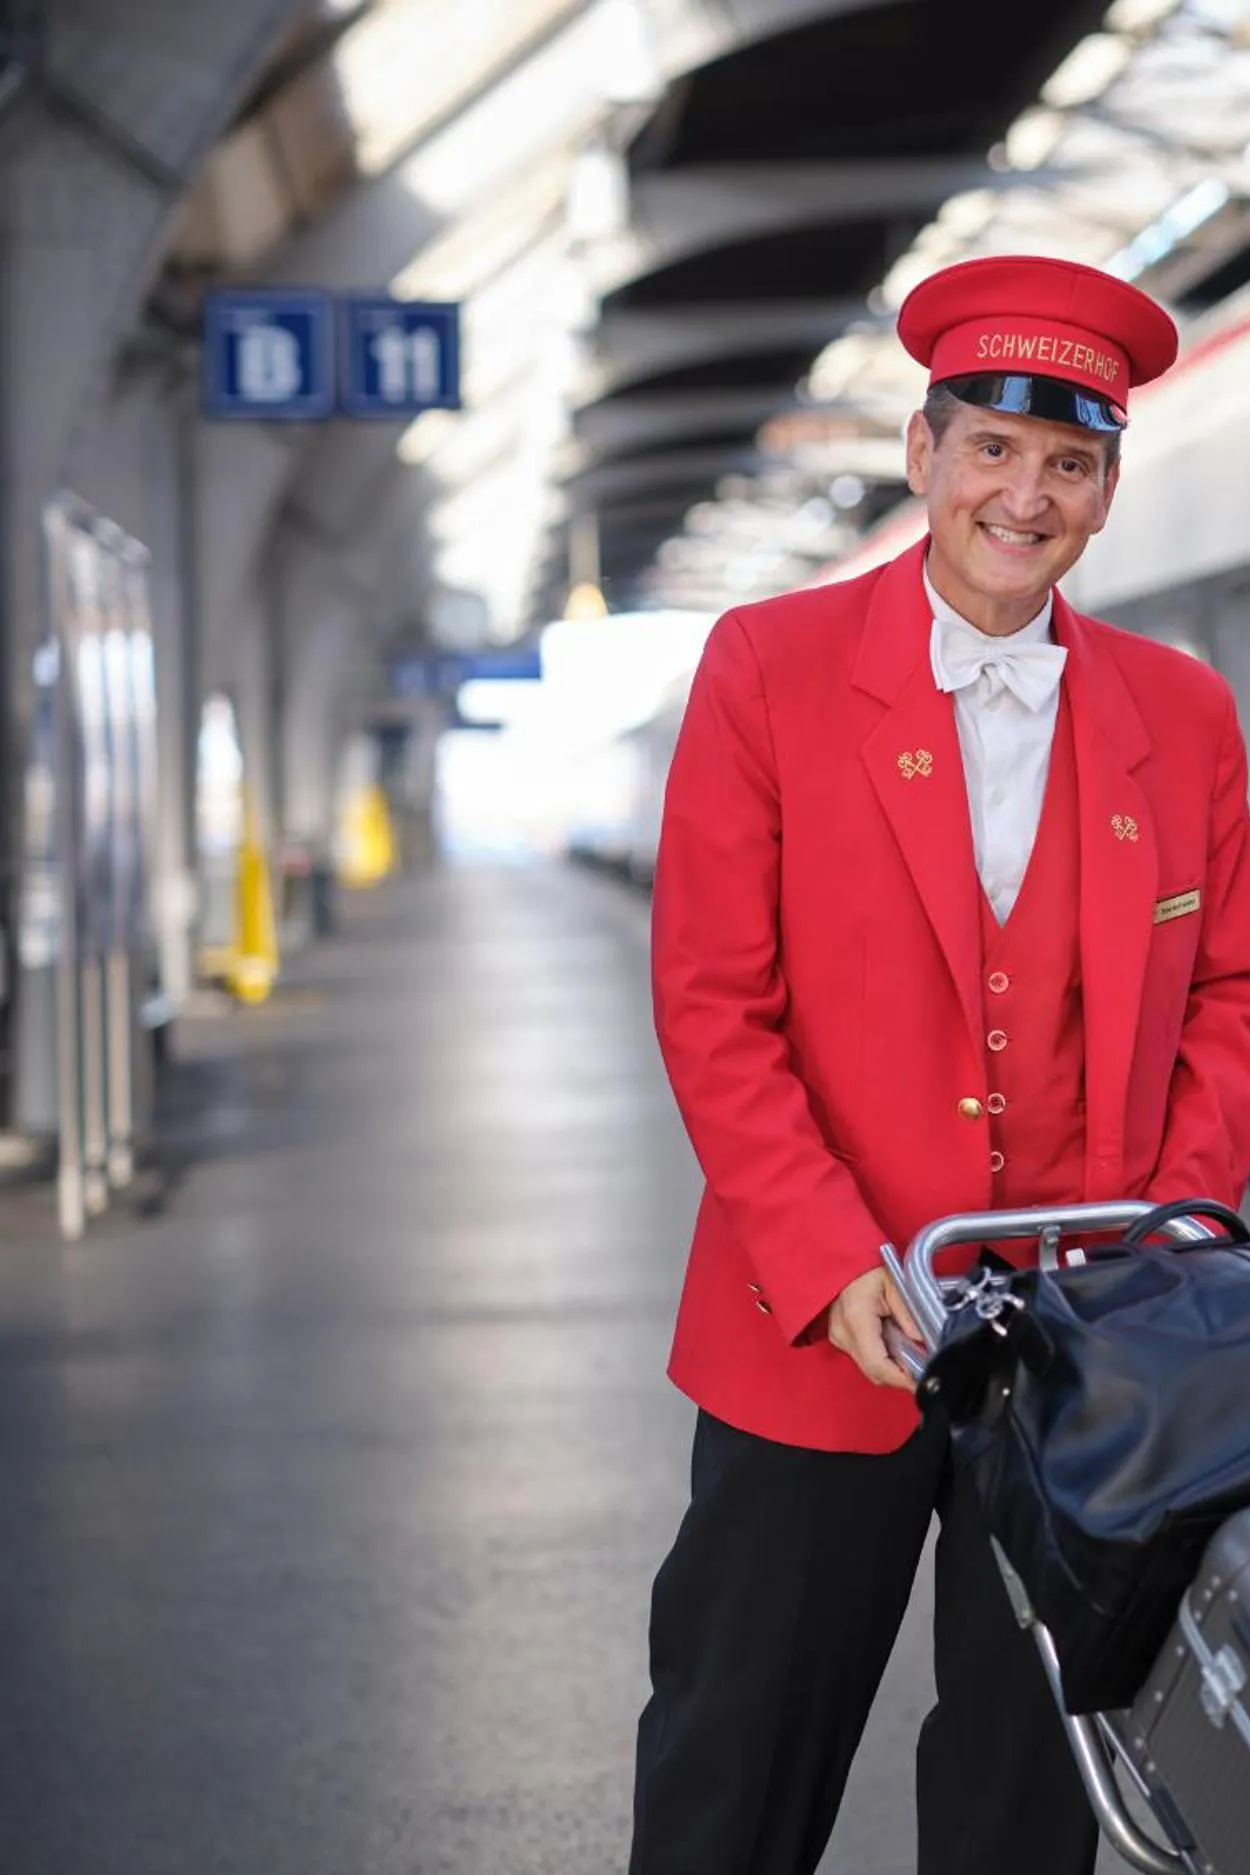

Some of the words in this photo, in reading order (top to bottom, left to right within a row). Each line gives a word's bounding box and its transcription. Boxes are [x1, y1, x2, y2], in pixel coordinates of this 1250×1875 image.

[237, 325, 301, 402] B
[371, 326, 439, 403] 11
[977, 334, 1120, 383] SCHWEIZERHOF
